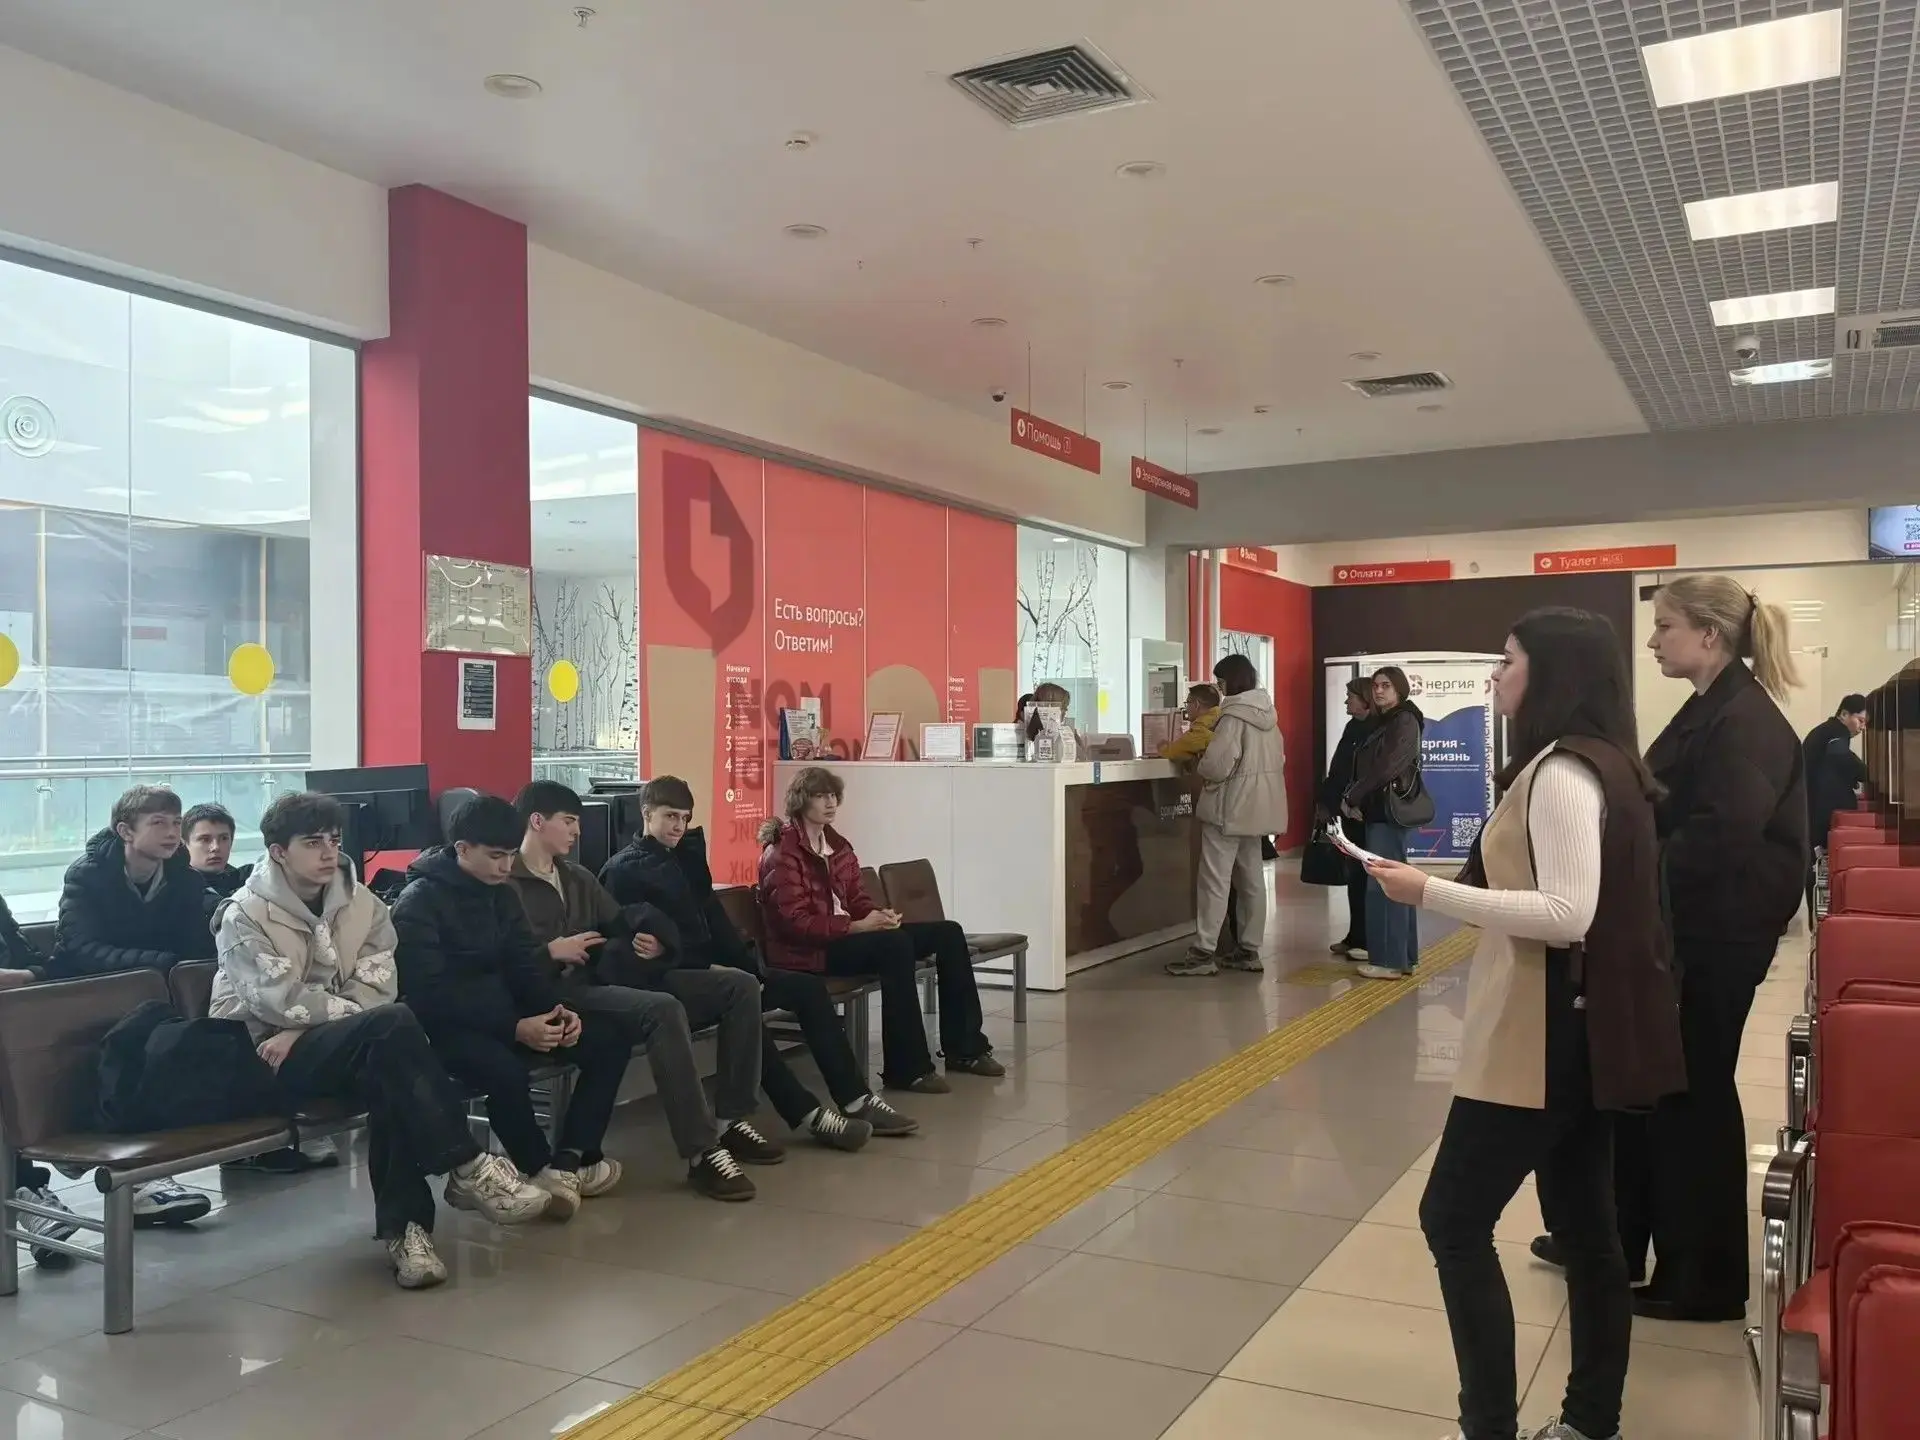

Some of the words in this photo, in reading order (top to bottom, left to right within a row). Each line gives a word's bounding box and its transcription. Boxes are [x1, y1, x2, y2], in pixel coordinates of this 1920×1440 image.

[1027, 422, 1062, 452] Помощь
[1559, 556, 1597, 569] Туалет
[1349, 569, 1383, 579] Оплата
[775, 597, 803, 620] Есть
[806, 607, 864, 628] вопросы?
[775, 629, 833, 654] Ответим!
[725, 692, 732, 708] 1
[725, 715, 732, 730] 2
[725, 735, 732, 752] 3
[1421, 739, 1457, 751] ергия
[725, 756, 732, 773] 4
[1429, 754, 1470, 762] жизнь
